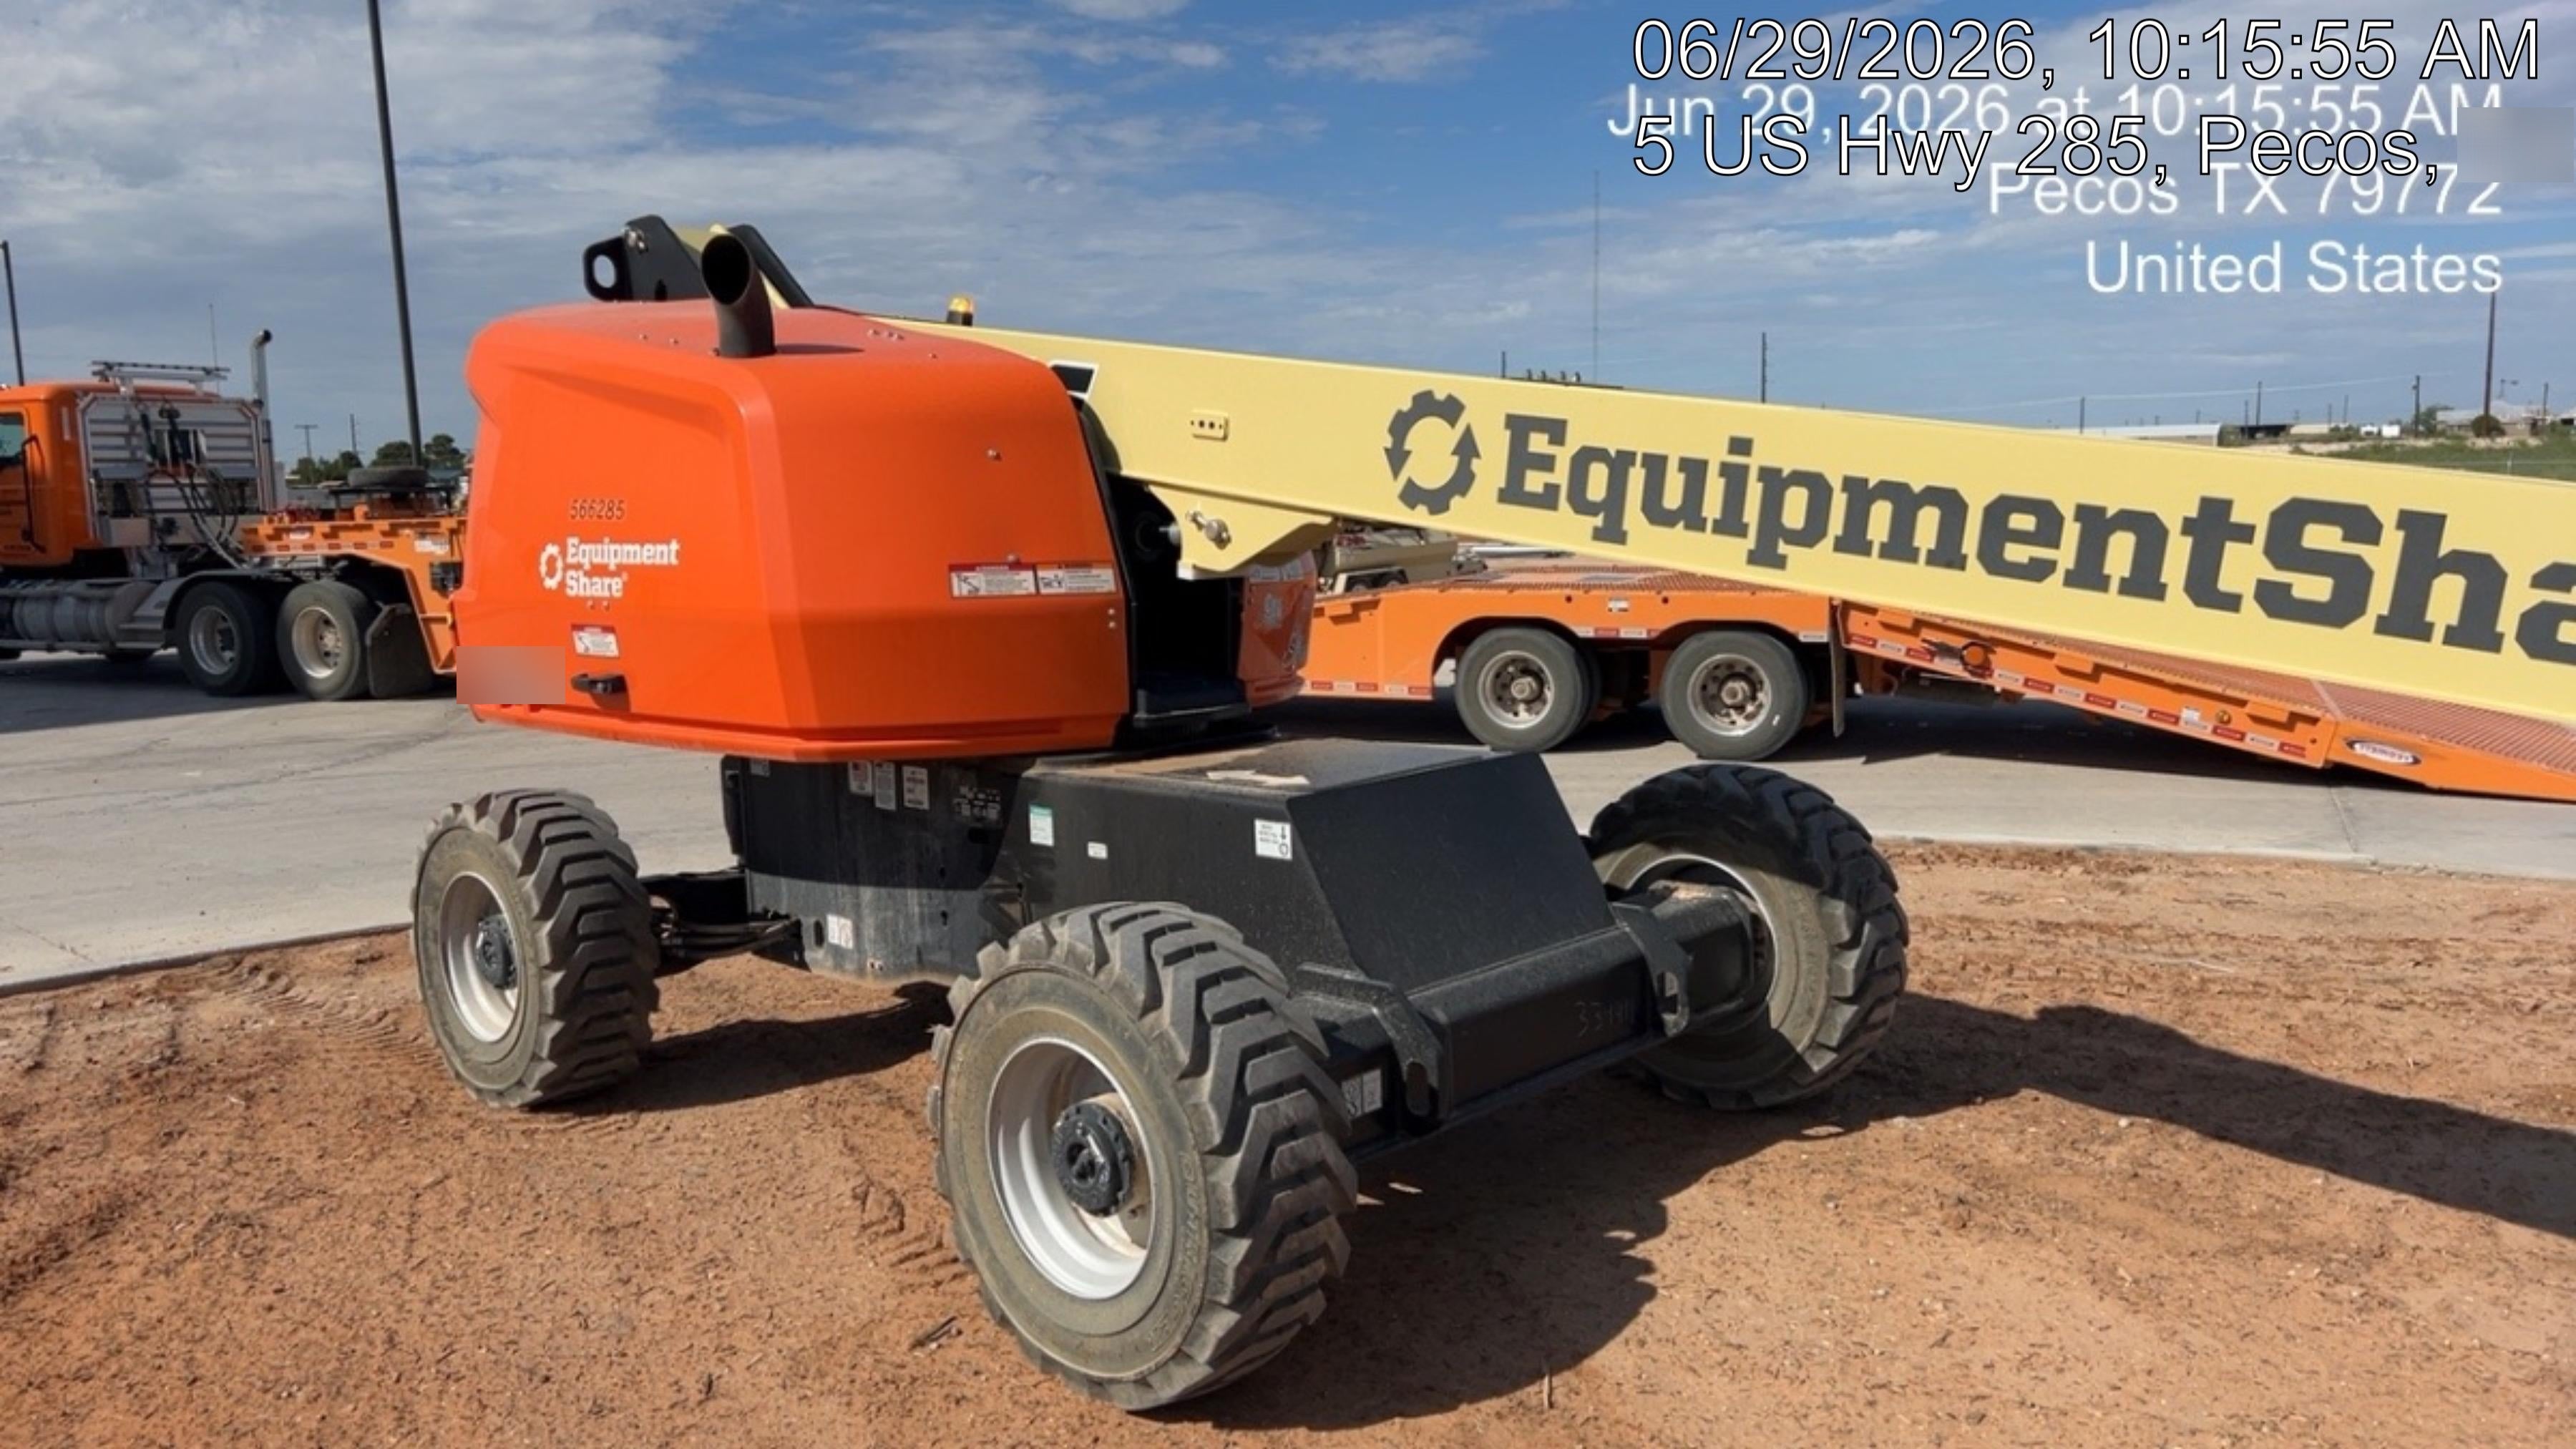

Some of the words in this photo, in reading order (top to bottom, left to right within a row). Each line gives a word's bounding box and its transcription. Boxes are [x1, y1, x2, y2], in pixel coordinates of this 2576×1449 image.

[570, 499, 625, 521] 566285
[566, 537, 680, 571] Equipment
[566, 570, 623, 598] Share
